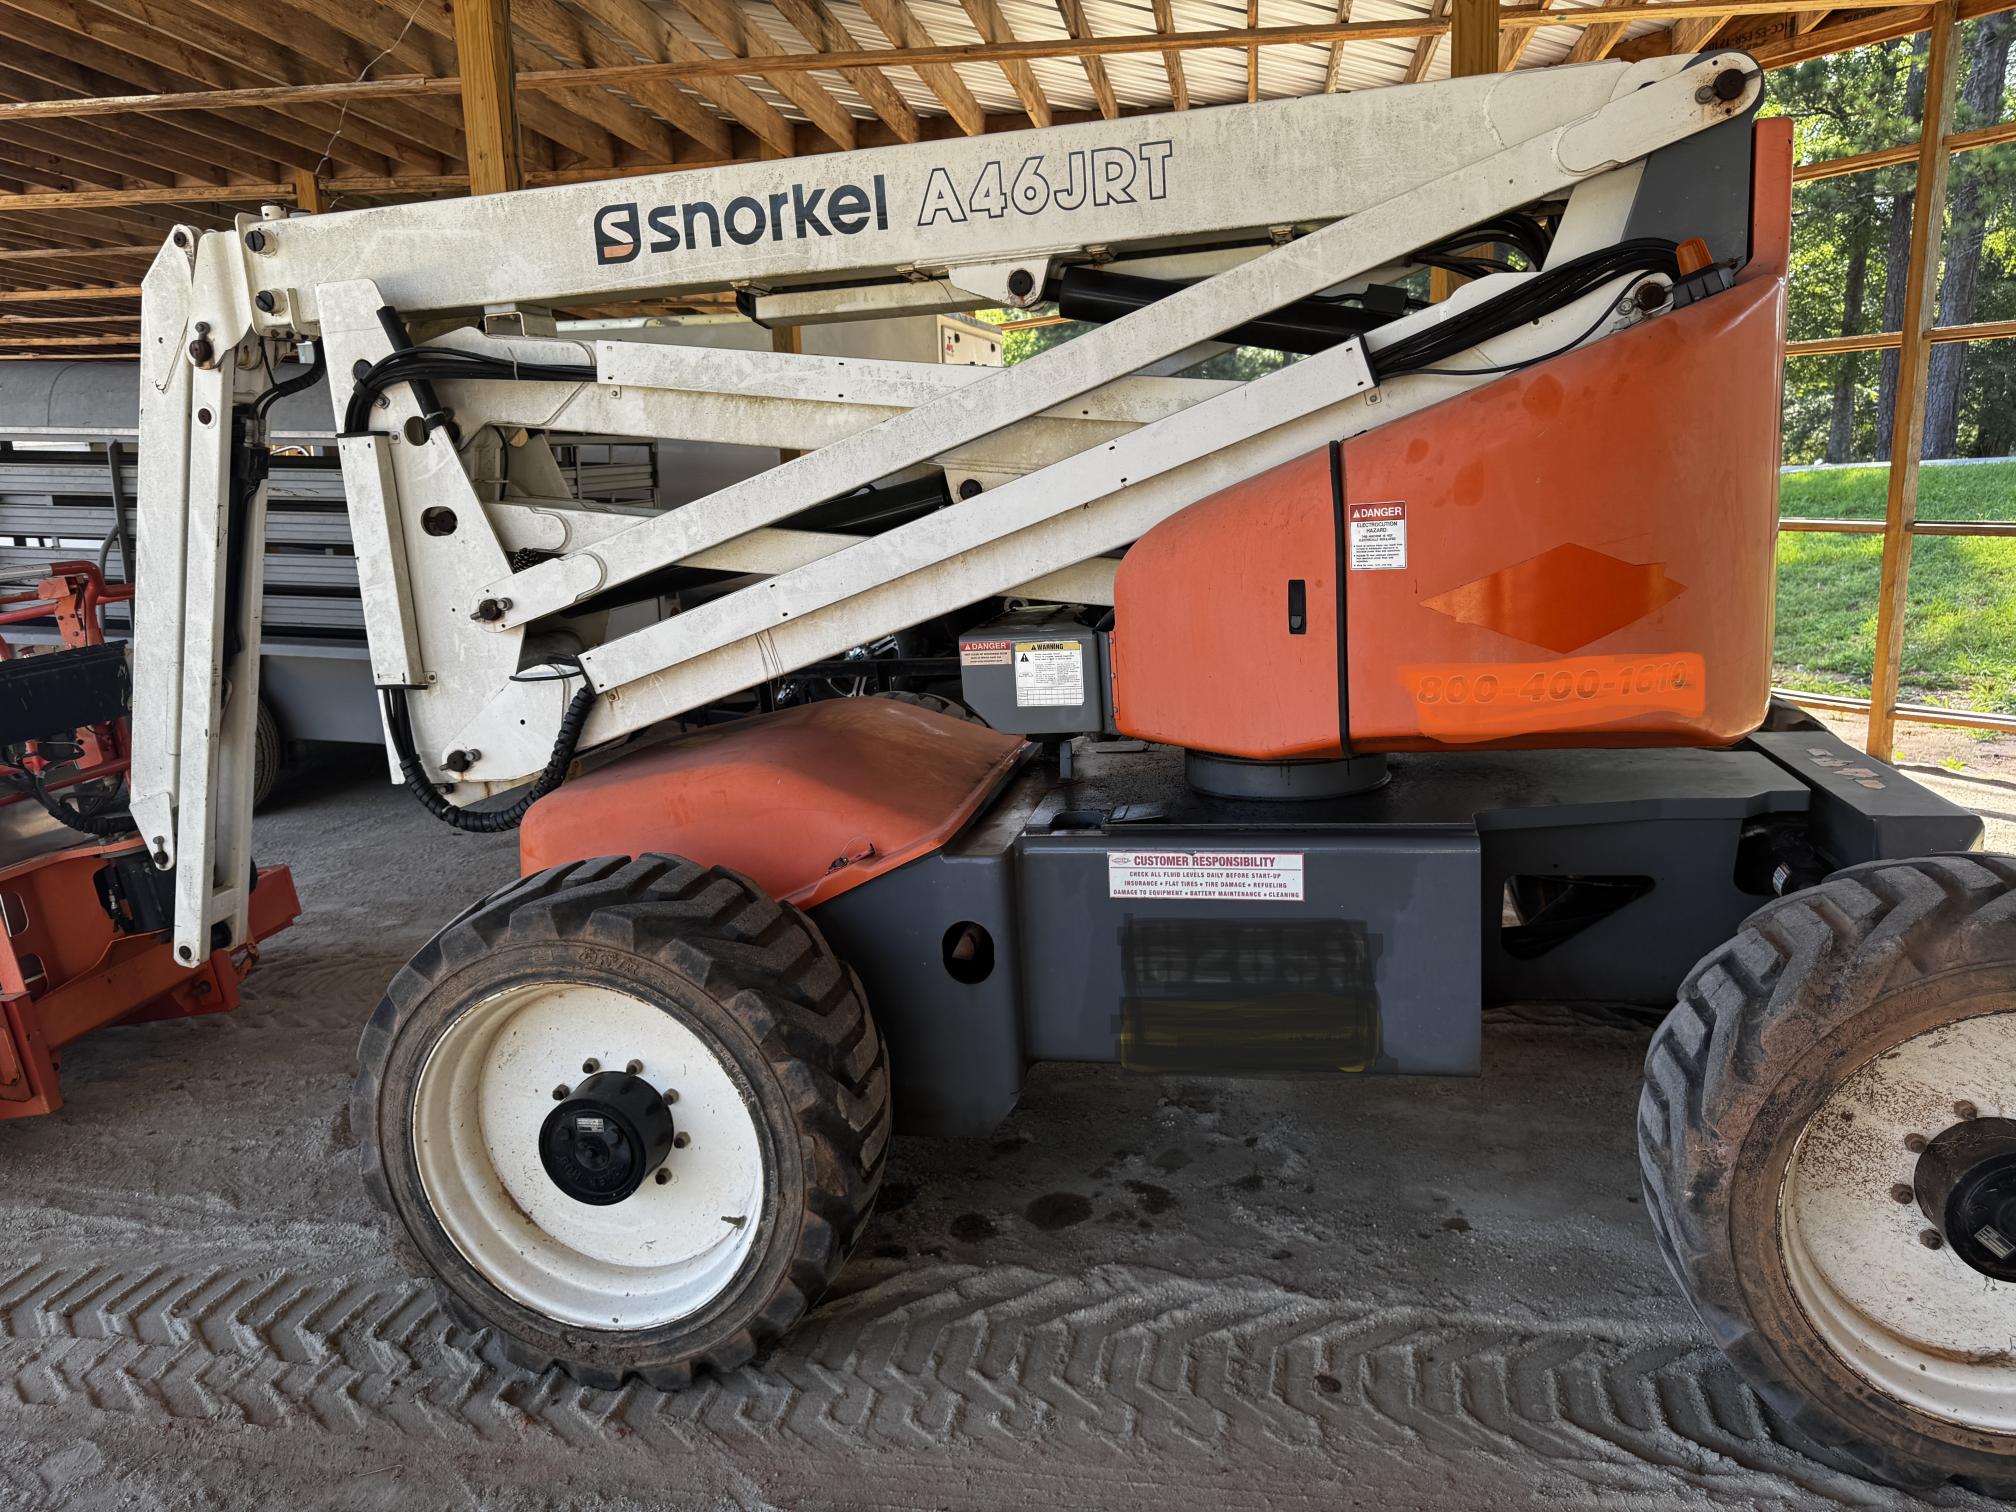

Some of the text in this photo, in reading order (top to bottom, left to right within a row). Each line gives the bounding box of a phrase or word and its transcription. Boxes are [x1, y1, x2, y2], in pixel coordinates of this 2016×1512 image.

[917, 140, 1173, 227] A46JRT
[649, 174, 889, 253] snorkel
[1361, 507, 1402, 518] DANGER
[972, 642, 1007, 650] DANGER
[1134, 855, 1189, 866] CUSTOMER
[1192, 856, 1276, 867] RESPONSIBILITY
